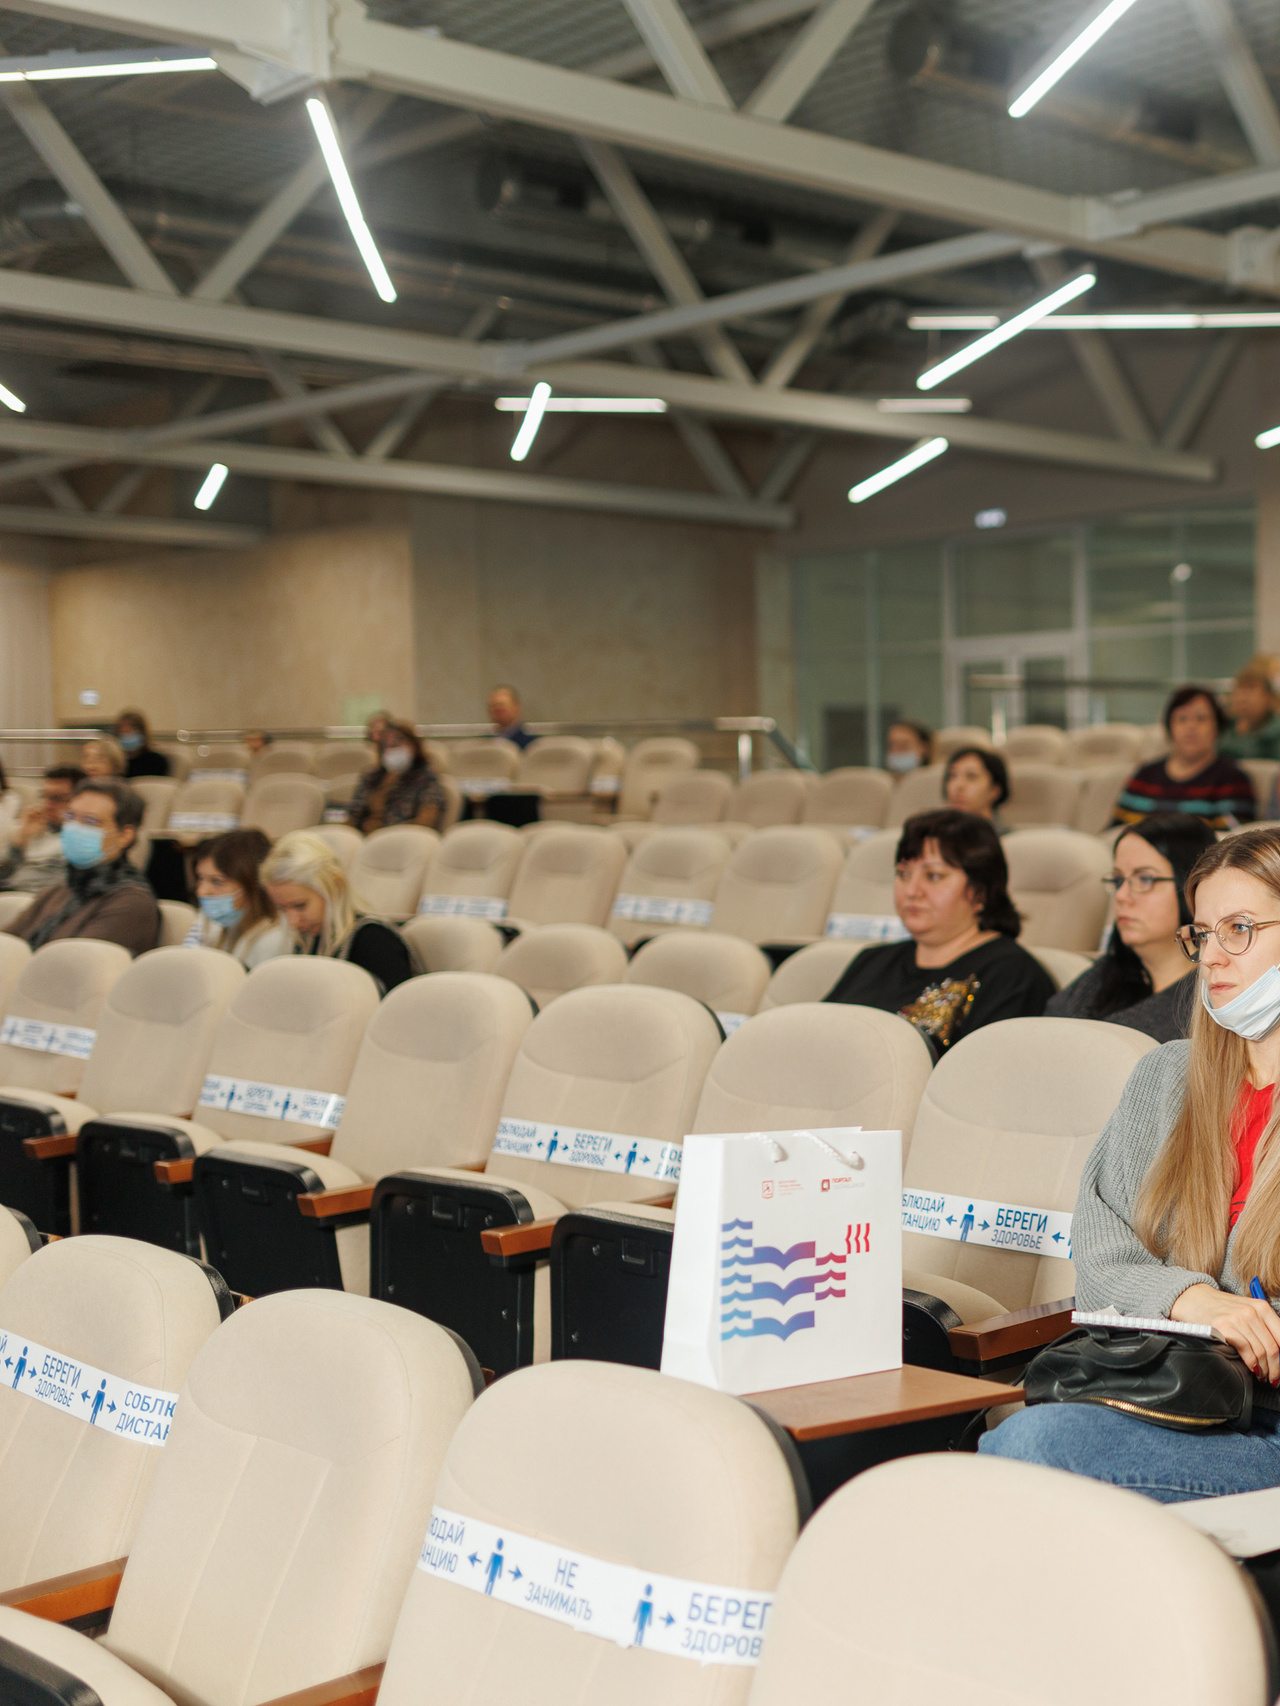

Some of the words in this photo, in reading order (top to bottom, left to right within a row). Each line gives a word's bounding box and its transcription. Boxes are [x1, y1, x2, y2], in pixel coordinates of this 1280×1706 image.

[573, 1132, 614, 1151] БЕРЕГИ
[568, 1150, 608, 1167] ЗДОРОВЬЕ
[996, 1208, 1049, 1233] БЕРЕГИ
[991, 1229, 1044, 1250] ЗДОРОВЬЕ
[41, 1354, 82, 1389] БЕРЕГИ
[35, 1378, 75, 1408] ЗДОРОВЬЕ
[429, 1514, 465, 1546] ЮДАЙ
[554, 1558, 579, 1589] НЕ
[524, 1581, 593, 1621] ЗАНИМАТЬ
[681, 1627, 763, 1659] ЗДОРОВ
